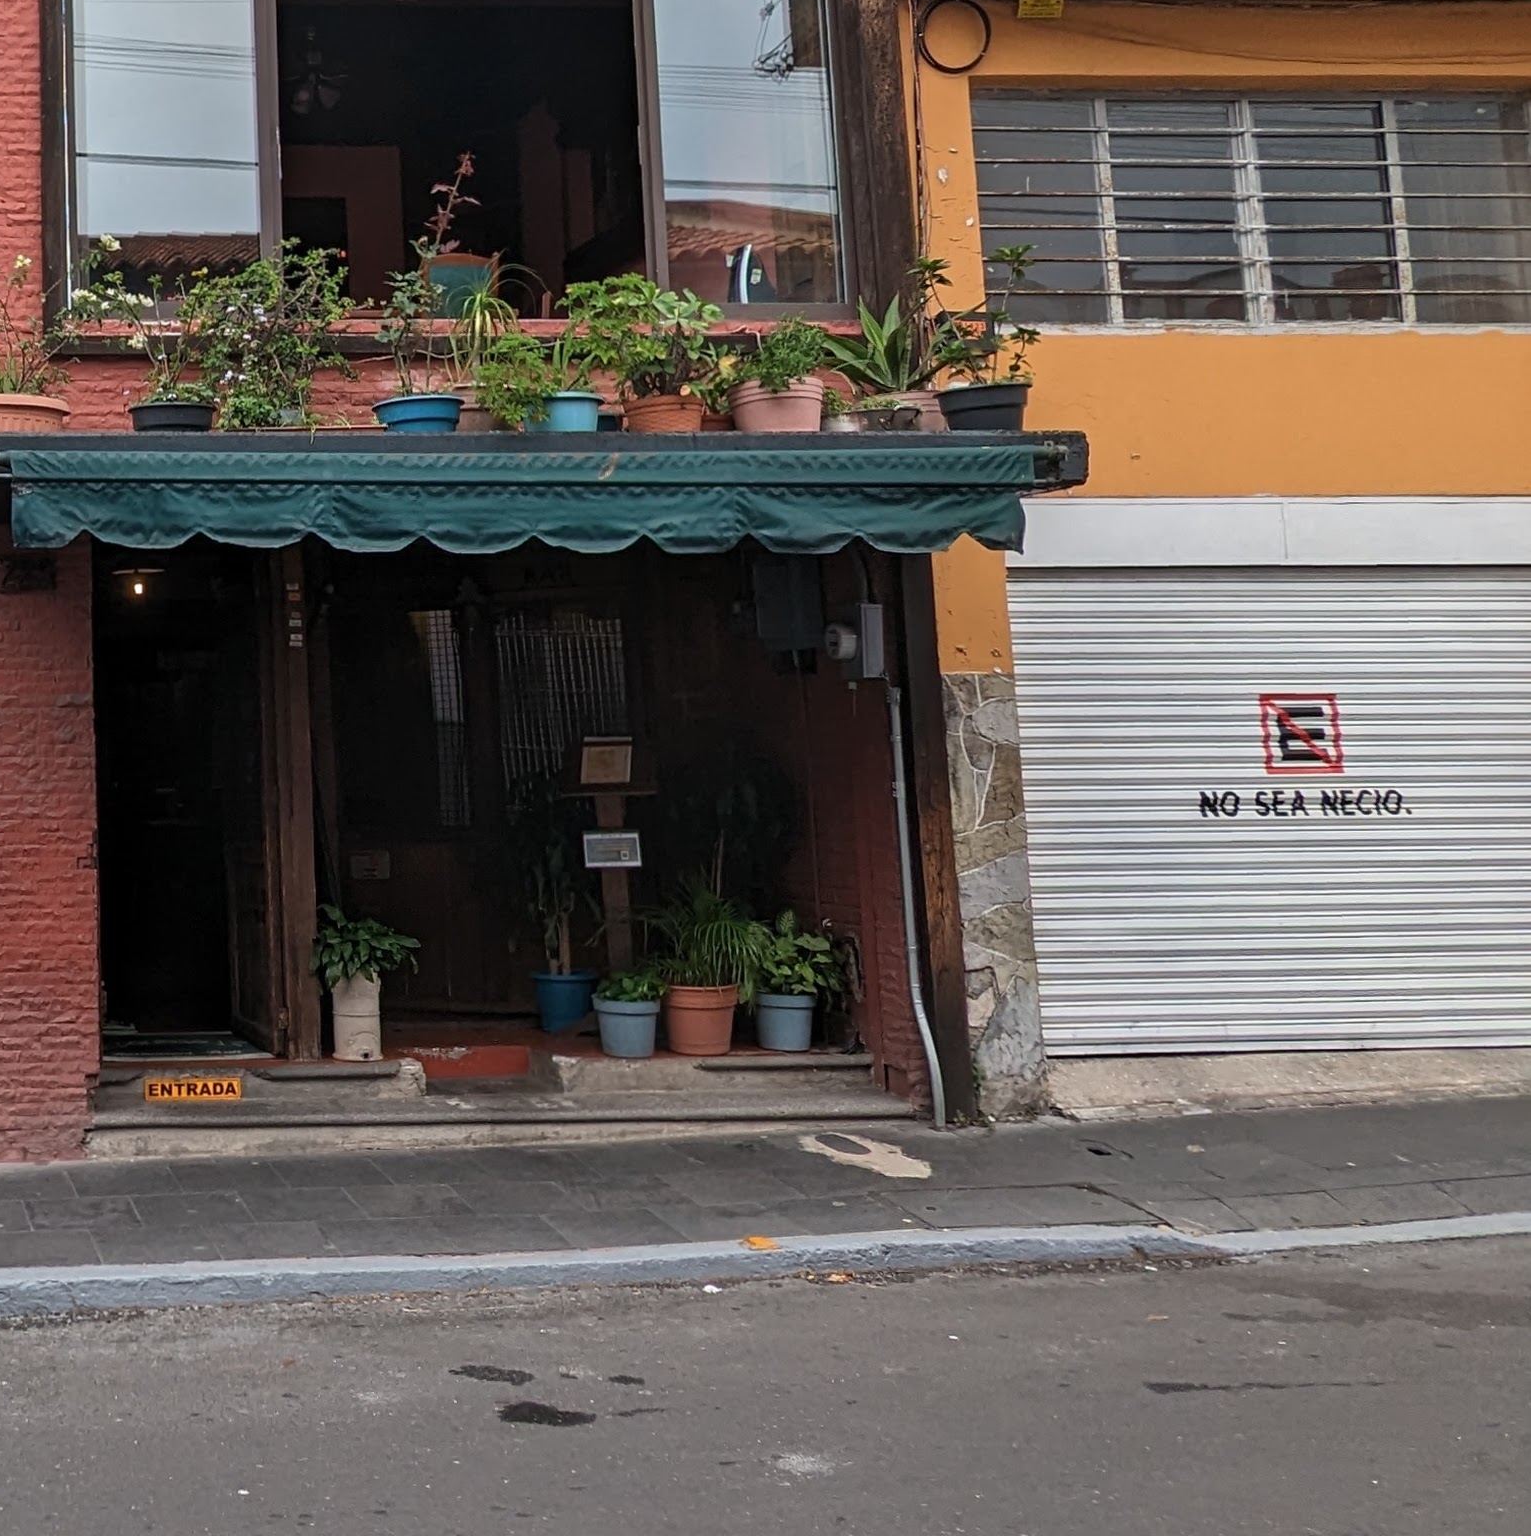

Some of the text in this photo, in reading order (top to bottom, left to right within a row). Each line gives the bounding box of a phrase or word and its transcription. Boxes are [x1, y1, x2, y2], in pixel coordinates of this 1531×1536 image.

[1199, 789, 1413, 818] NO SEA NECIO.
[148, 1082, 237, 1097] ENTRADA
